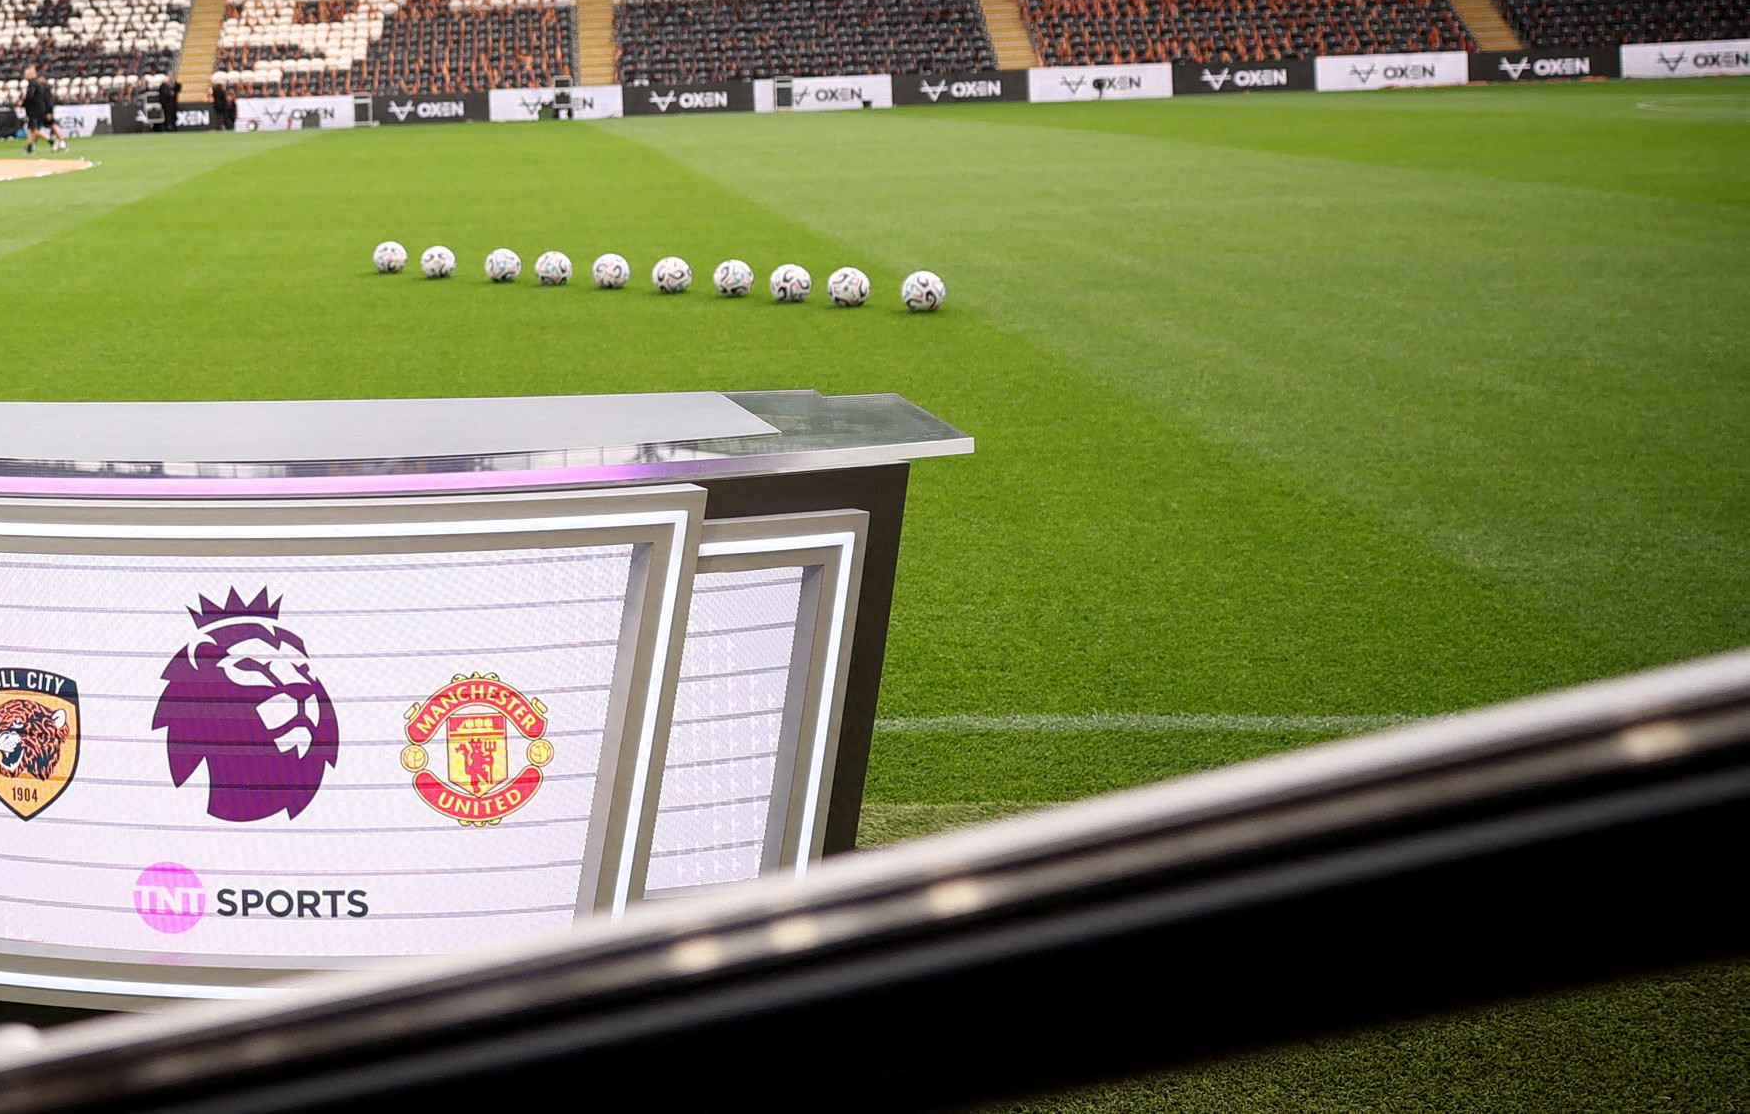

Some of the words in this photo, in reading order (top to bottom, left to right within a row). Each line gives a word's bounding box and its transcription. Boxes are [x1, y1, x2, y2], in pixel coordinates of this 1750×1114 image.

[1533, 57, 1591, 76] OXEN
[1693, 50, 1748, 69] OXEN
[1233, 68, 1287, 87] OXEN
[1384, 64, 1436, 80] OXEN
[950, 79, 1001, 98] OXEN
[1095, 75, 1142, 91] XEN
[678, 90, 728, 109] OXEN
[815, 86, 862, 102] OXEN
[174, 110, 210, 126] XEN
[416, 101, 464, 118] OXEN
[26, 671, 65, 694] CITY
[416, 684, 537, 734] MANCHESTER
[12, 787, 38, 803] 1904
[438, 789, 522, 816] UNITED
[134, 886, 205, 916] TNT
[216, 888, 369, 918] SPORTS
